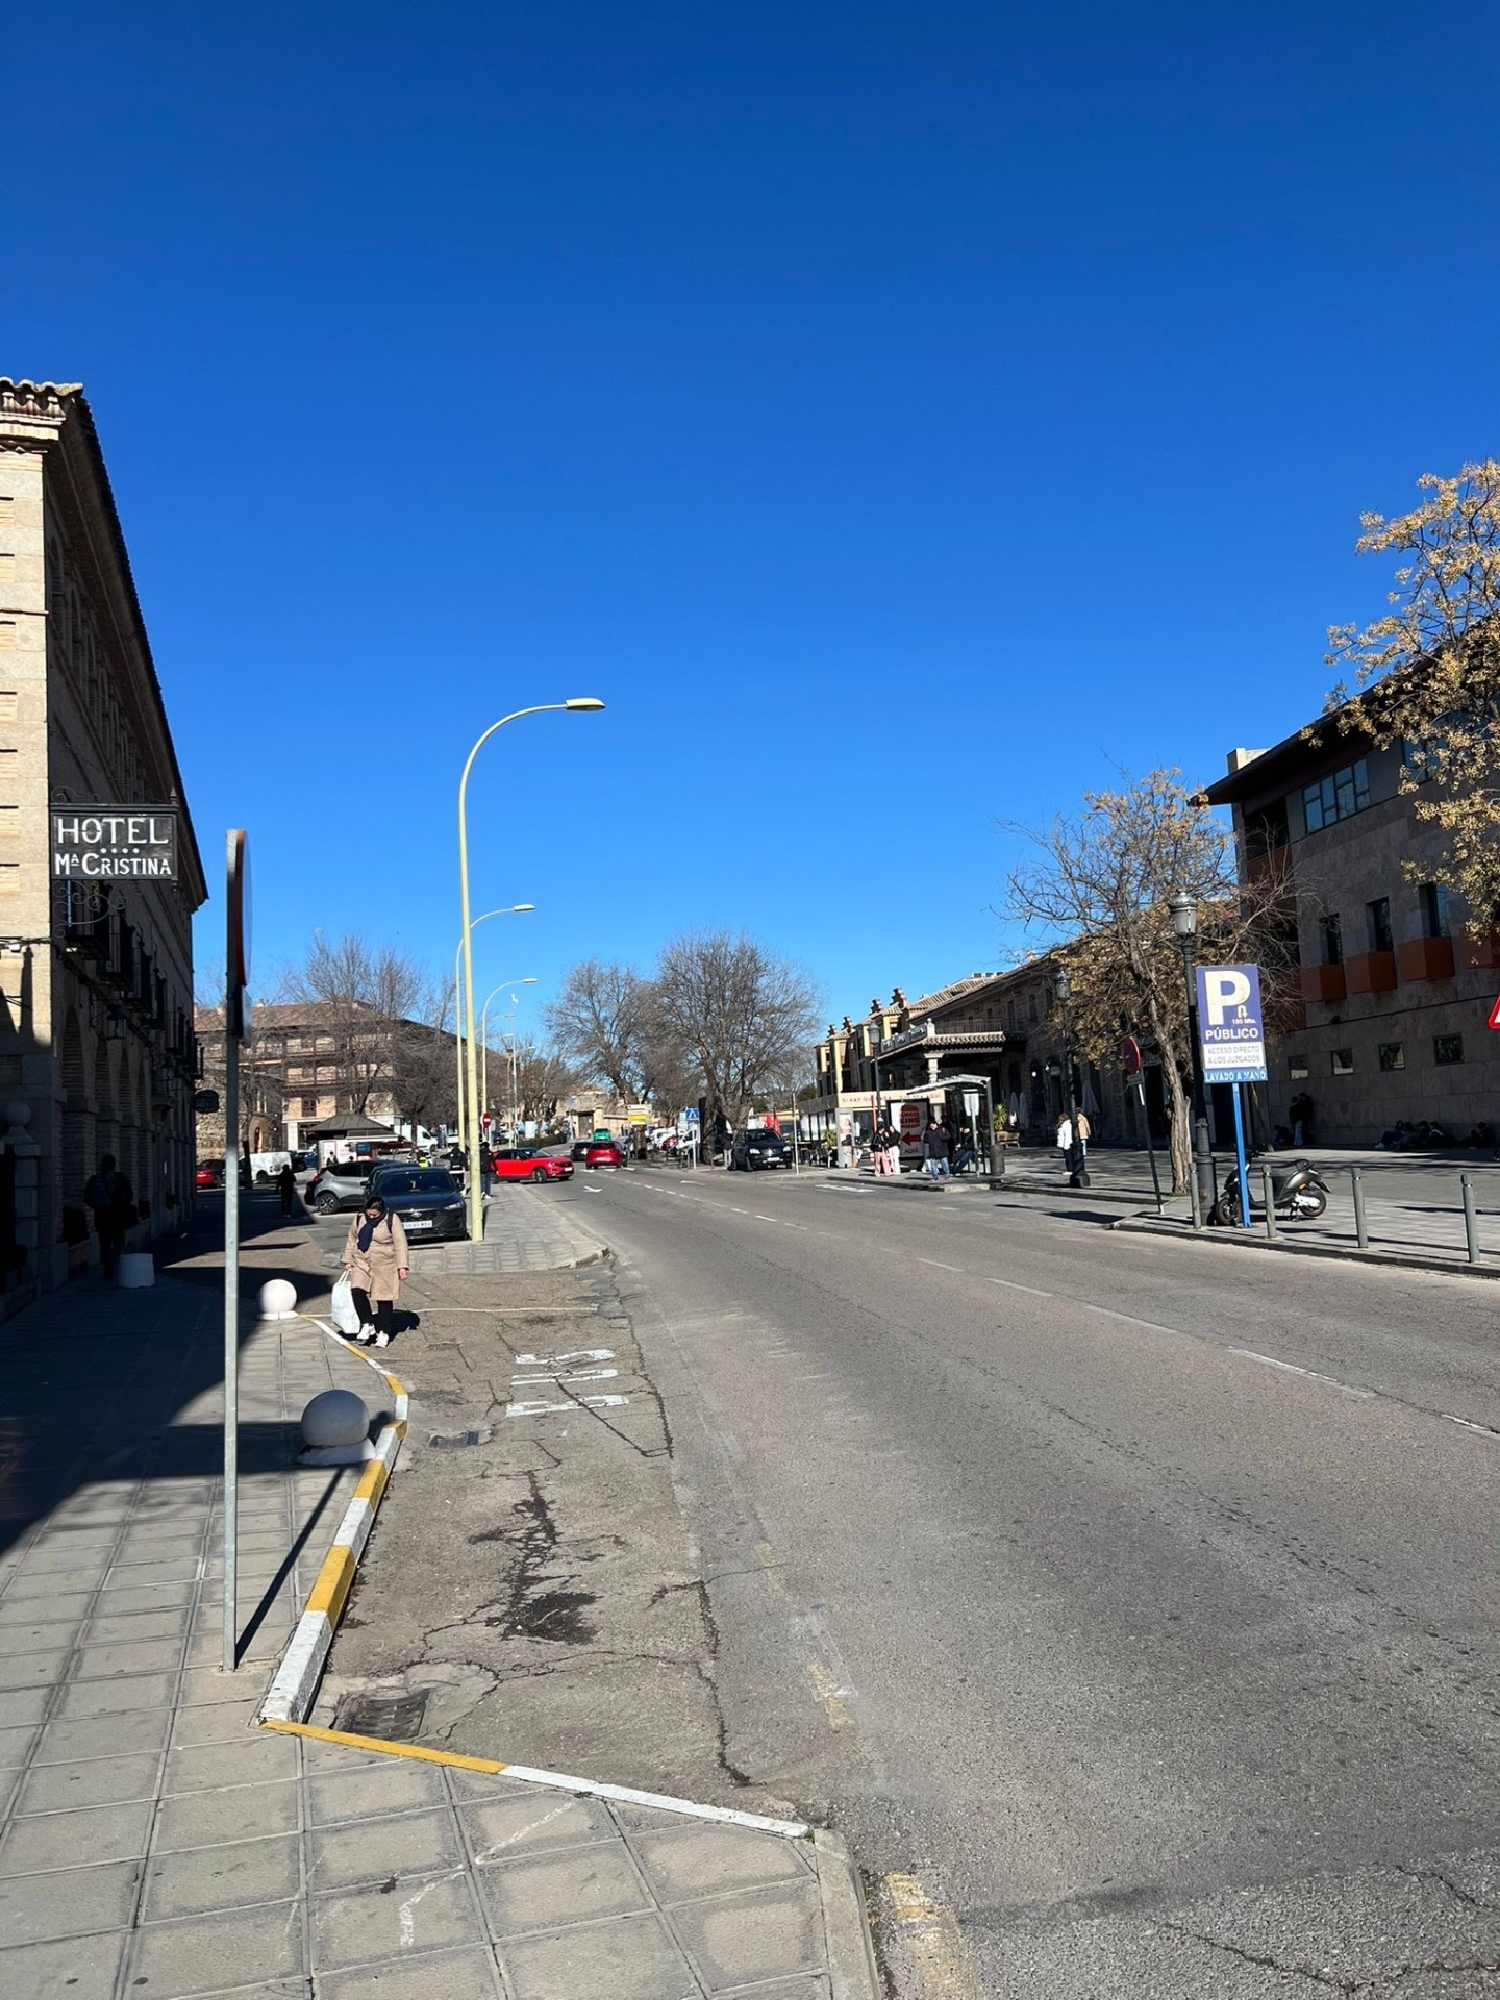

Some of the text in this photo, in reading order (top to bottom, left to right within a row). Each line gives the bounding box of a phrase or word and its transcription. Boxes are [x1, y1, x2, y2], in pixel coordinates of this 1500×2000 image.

[57, 817, 169, 844] HOTEL
[1205, 970, 1251, 1025] P
[1205, 1027, 1258, 1040] PÚBLICO
[1207, 1045, 1259, 1054] ACCESO DIRECTO
[1214, 1056, 1226, 1064] LOS
[1227, 1055, 1260, 1064] JUZGADOS
[1205, 1070, 1266, 1081] LAVADO A MANO
[900, 1116, 920, 1124] KING
